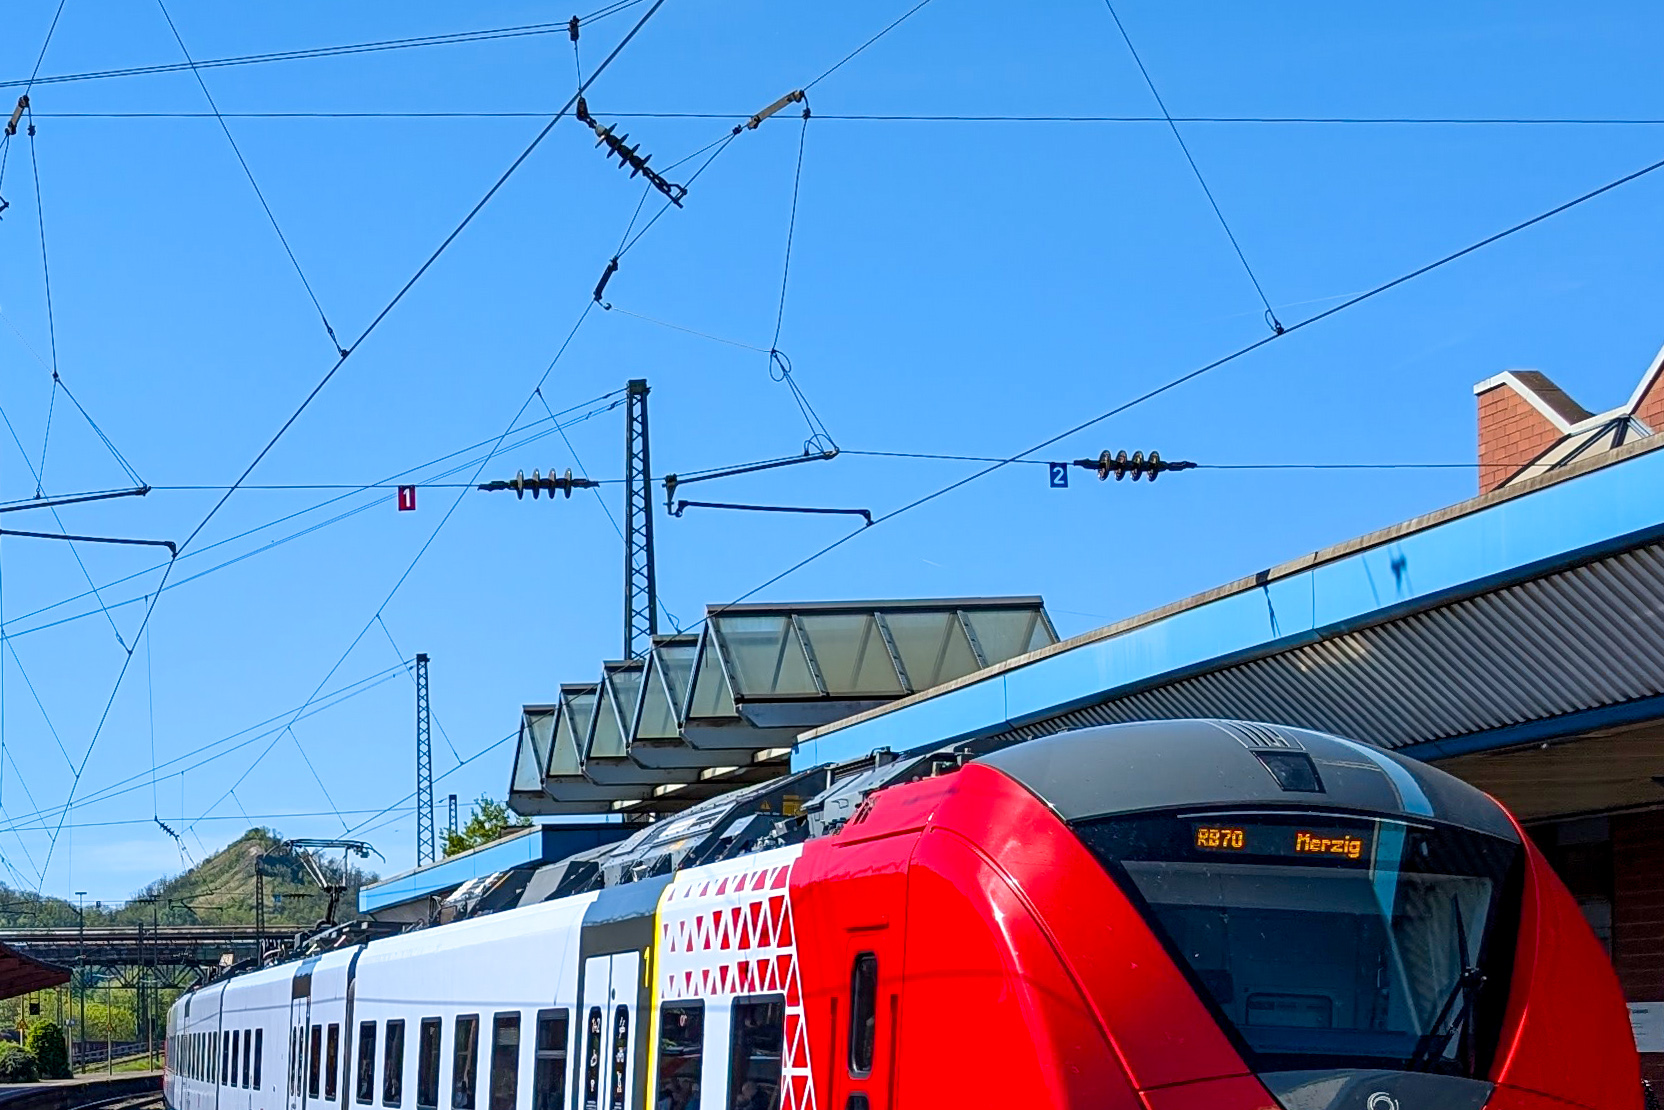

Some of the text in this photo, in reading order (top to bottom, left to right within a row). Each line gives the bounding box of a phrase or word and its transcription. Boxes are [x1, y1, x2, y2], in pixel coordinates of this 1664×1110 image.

[1052, 466, 1065, 485] 2
[403, 488, 411, 508] 1
[1197, 828, 1362, 859] RB70 Merzig
[644, 946, 650, 988] 1
